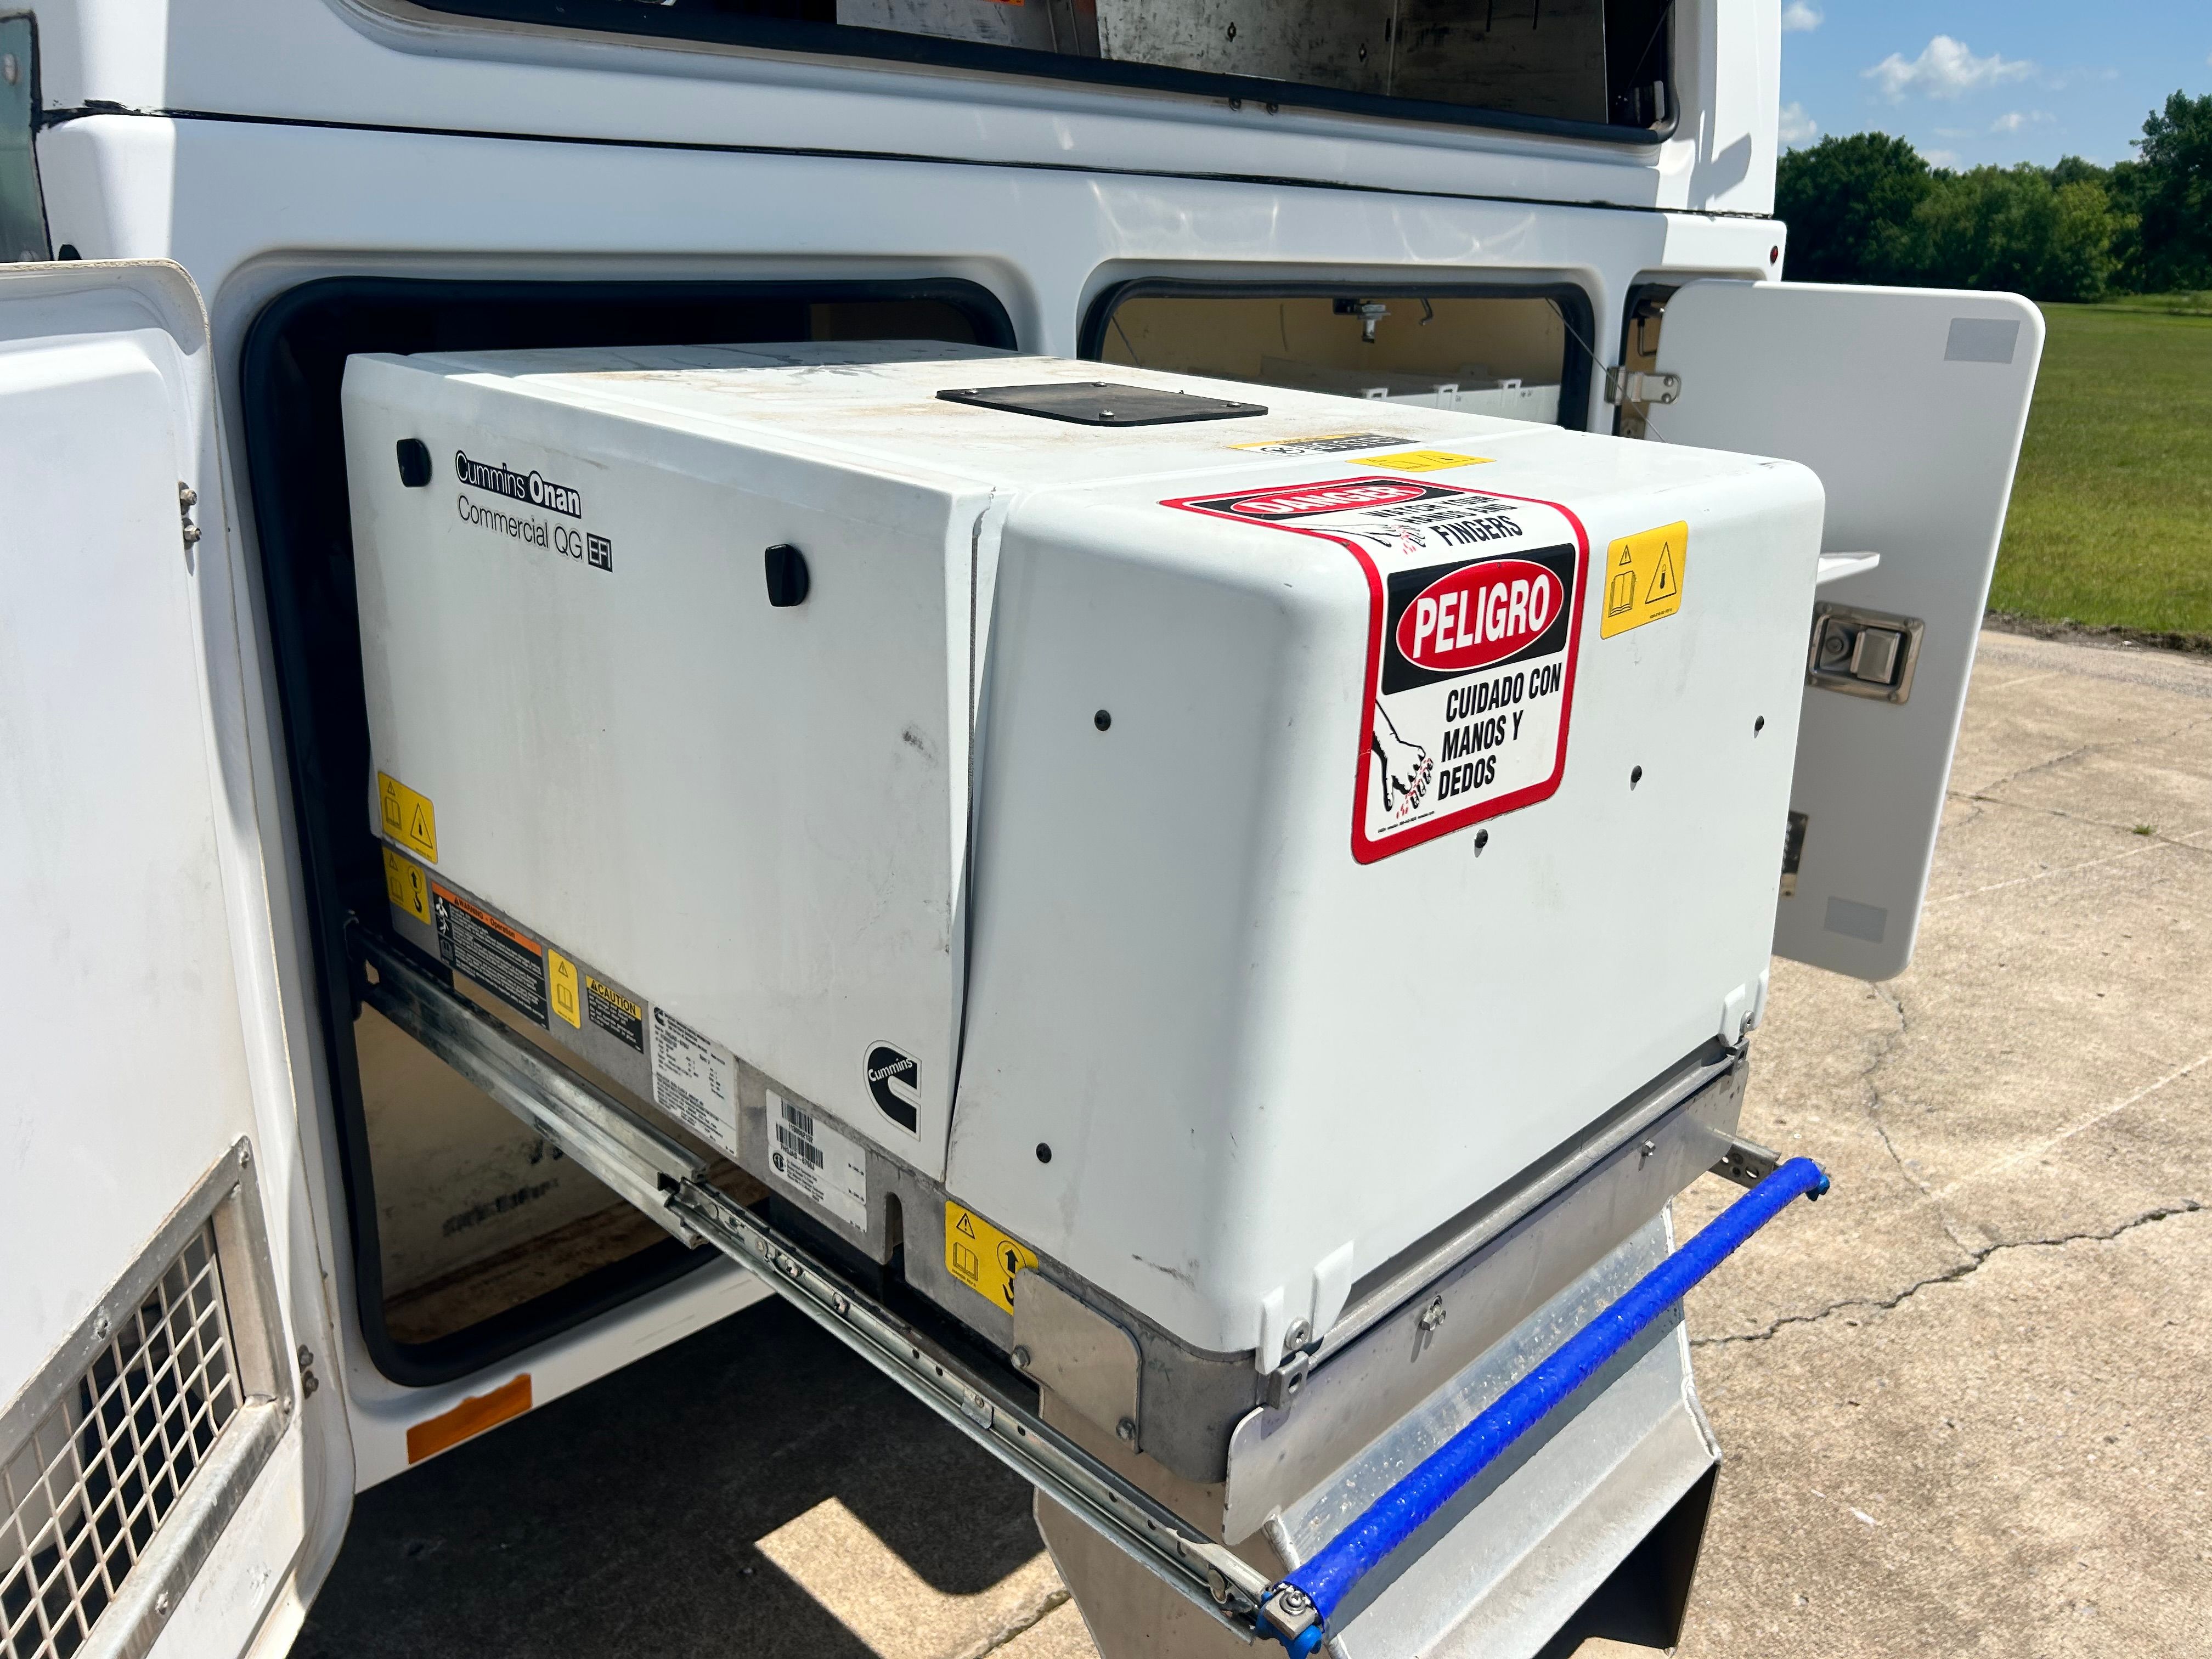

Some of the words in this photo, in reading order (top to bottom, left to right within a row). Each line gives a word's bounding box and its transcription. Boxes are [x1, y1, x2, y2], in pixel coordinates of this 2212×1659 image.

[456, 453, 526, 499] Cummins
[529, 470, 580, 515] Onan
[1239, 486, 1421, 514] DANGER
[1358, 503, 1449, 517] WATCH
[1434, 496, 1502, 506] YOUR
[1392, 510, 1477, 524] HANDS
[1465, 504, 1518, 514] AND
[459, 495, 549, 549] Commercial
[554, 526, 583, 560] QG
[588, 537, 611, 569] EFI
[1428, 515, 1523, 546] FINGERS
[1412, 574, 1550, 659] PELIGRO
[1446, 672, 1524, 723] CUIDADO
[1528, 662, 1562, 699] CON
[1441, 714, 1506, 763] MANOS
[1513, 709, 1524, 741] Y
[1437, 754, 1497, 801] DEDOS
[459, 899, 484, 920] WARNING
[490, 917, 516, 939] Operation
[597, 984, 637, 1015] CAUTION
[868, 1058, 913, 1082] Cummins
